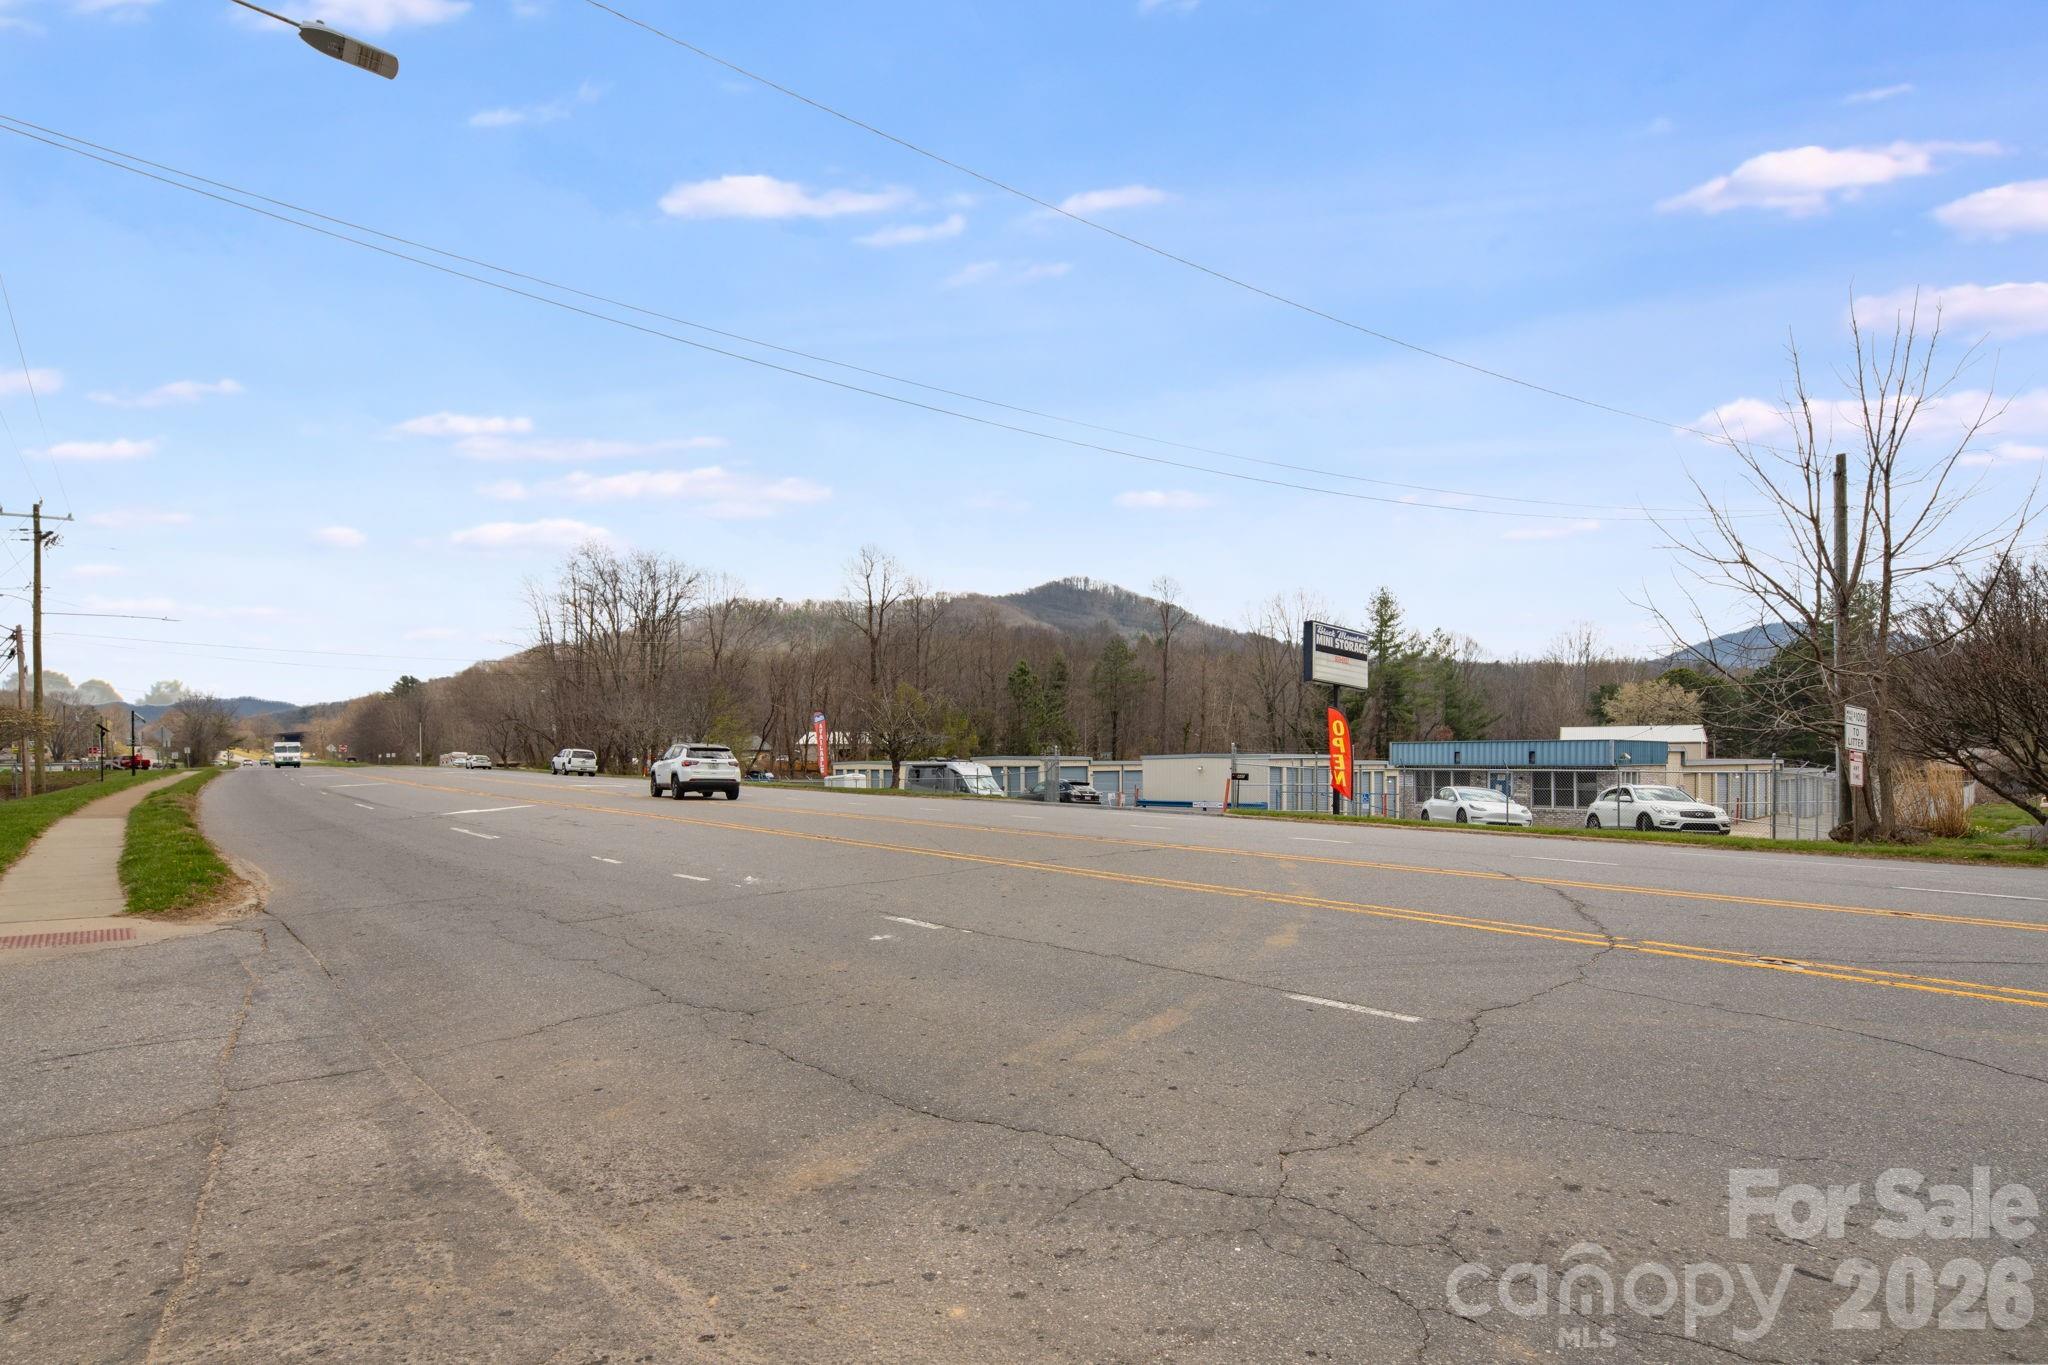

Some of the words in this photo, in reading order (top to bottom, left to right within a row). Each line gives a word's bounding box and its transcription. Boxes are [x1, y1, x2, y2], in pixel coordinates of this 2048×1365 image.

[1316, 634, 1334, 647] MINI
[1335, 638, 1368, 654] STORAGE
[1853, 728, 1859, 737] TO
[1848, 737, 1864, 748] LITTER
